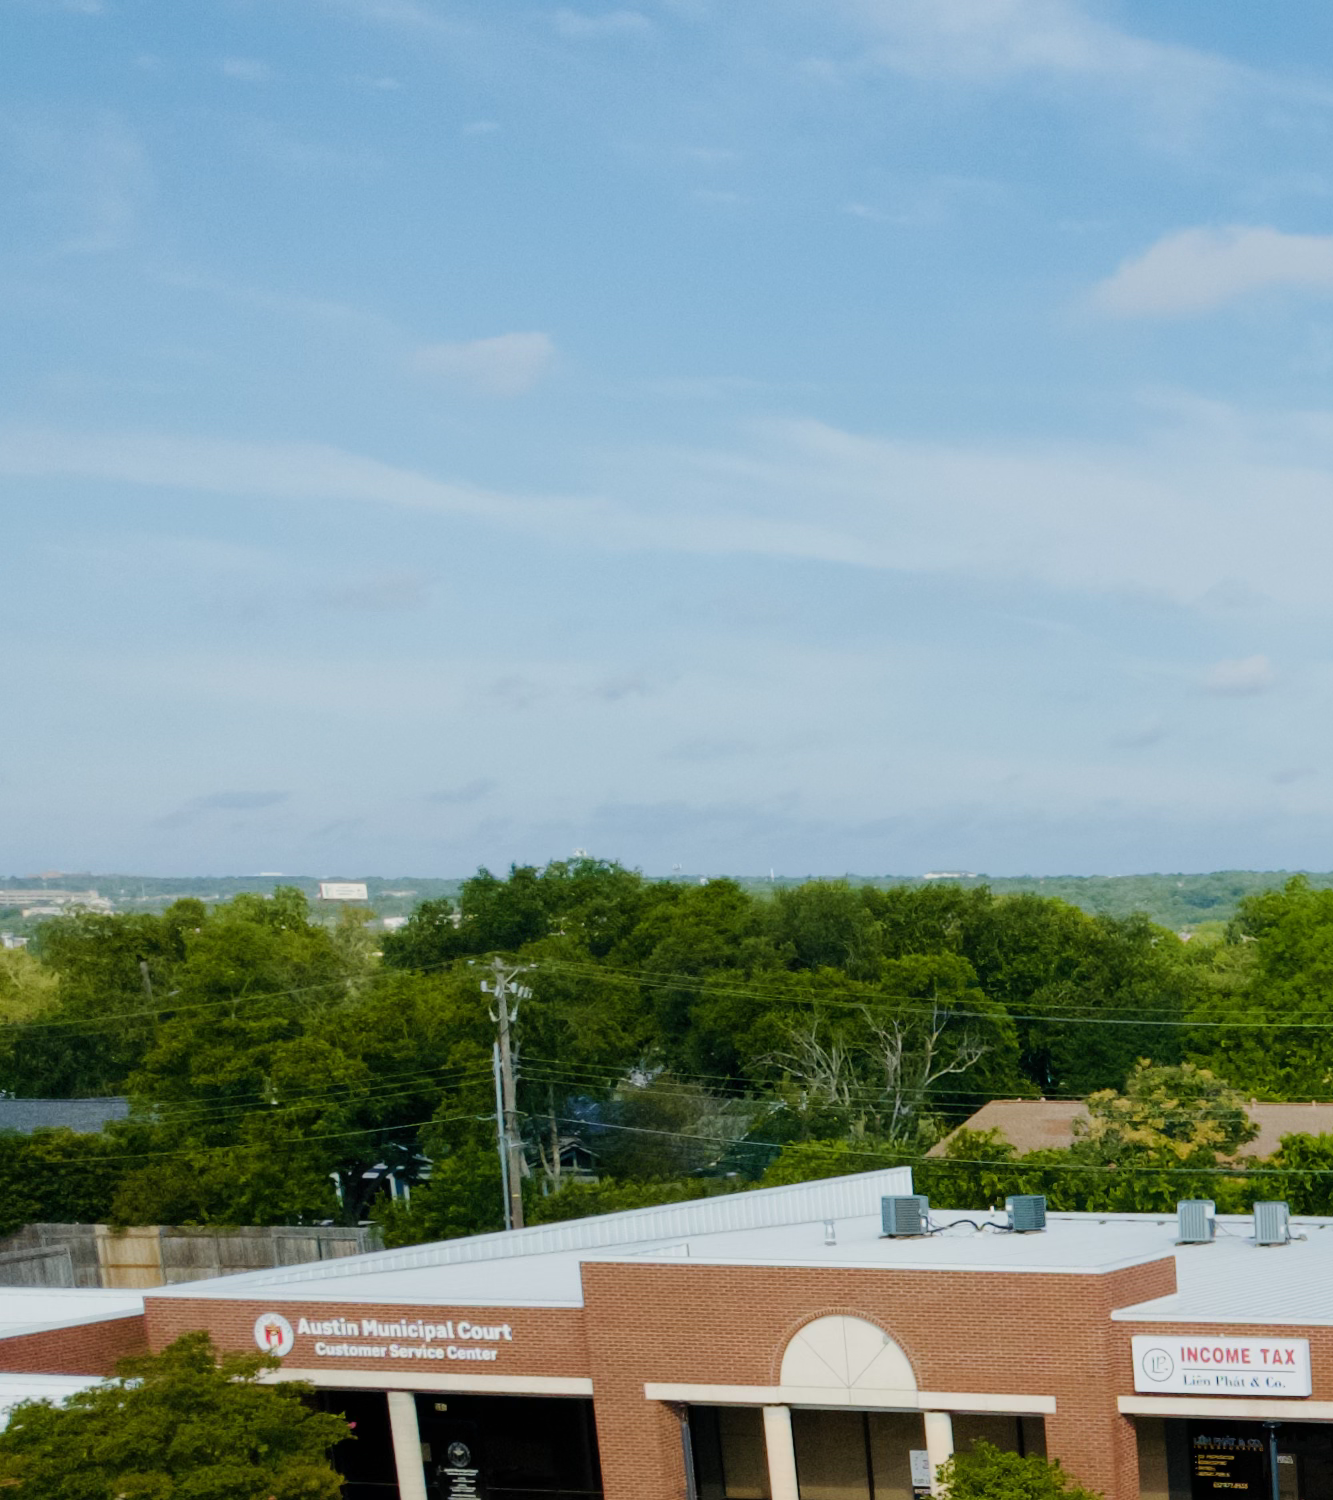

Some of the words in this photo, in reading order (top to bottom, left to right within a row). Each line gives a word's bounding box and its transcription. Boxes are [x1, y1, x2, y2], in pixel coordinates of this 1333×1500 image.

[298, 1318, 359, 1337] Austin
[361, 1320, 455, 1342] Municipal
[457, 1322, 513, 1341] Court
[315, 1342, 388, 1358] Customer
[389, 1344, 445, 1360] Service
[447, 1346, 499, 1361] Center
[1181, 1347, 1251, 1364] INCOME
[1260, 1348, 1297, 1366] TAX
[1250, 1377, 1261, 1388] &
[1265, 1377, 1286, 1388] Co.
